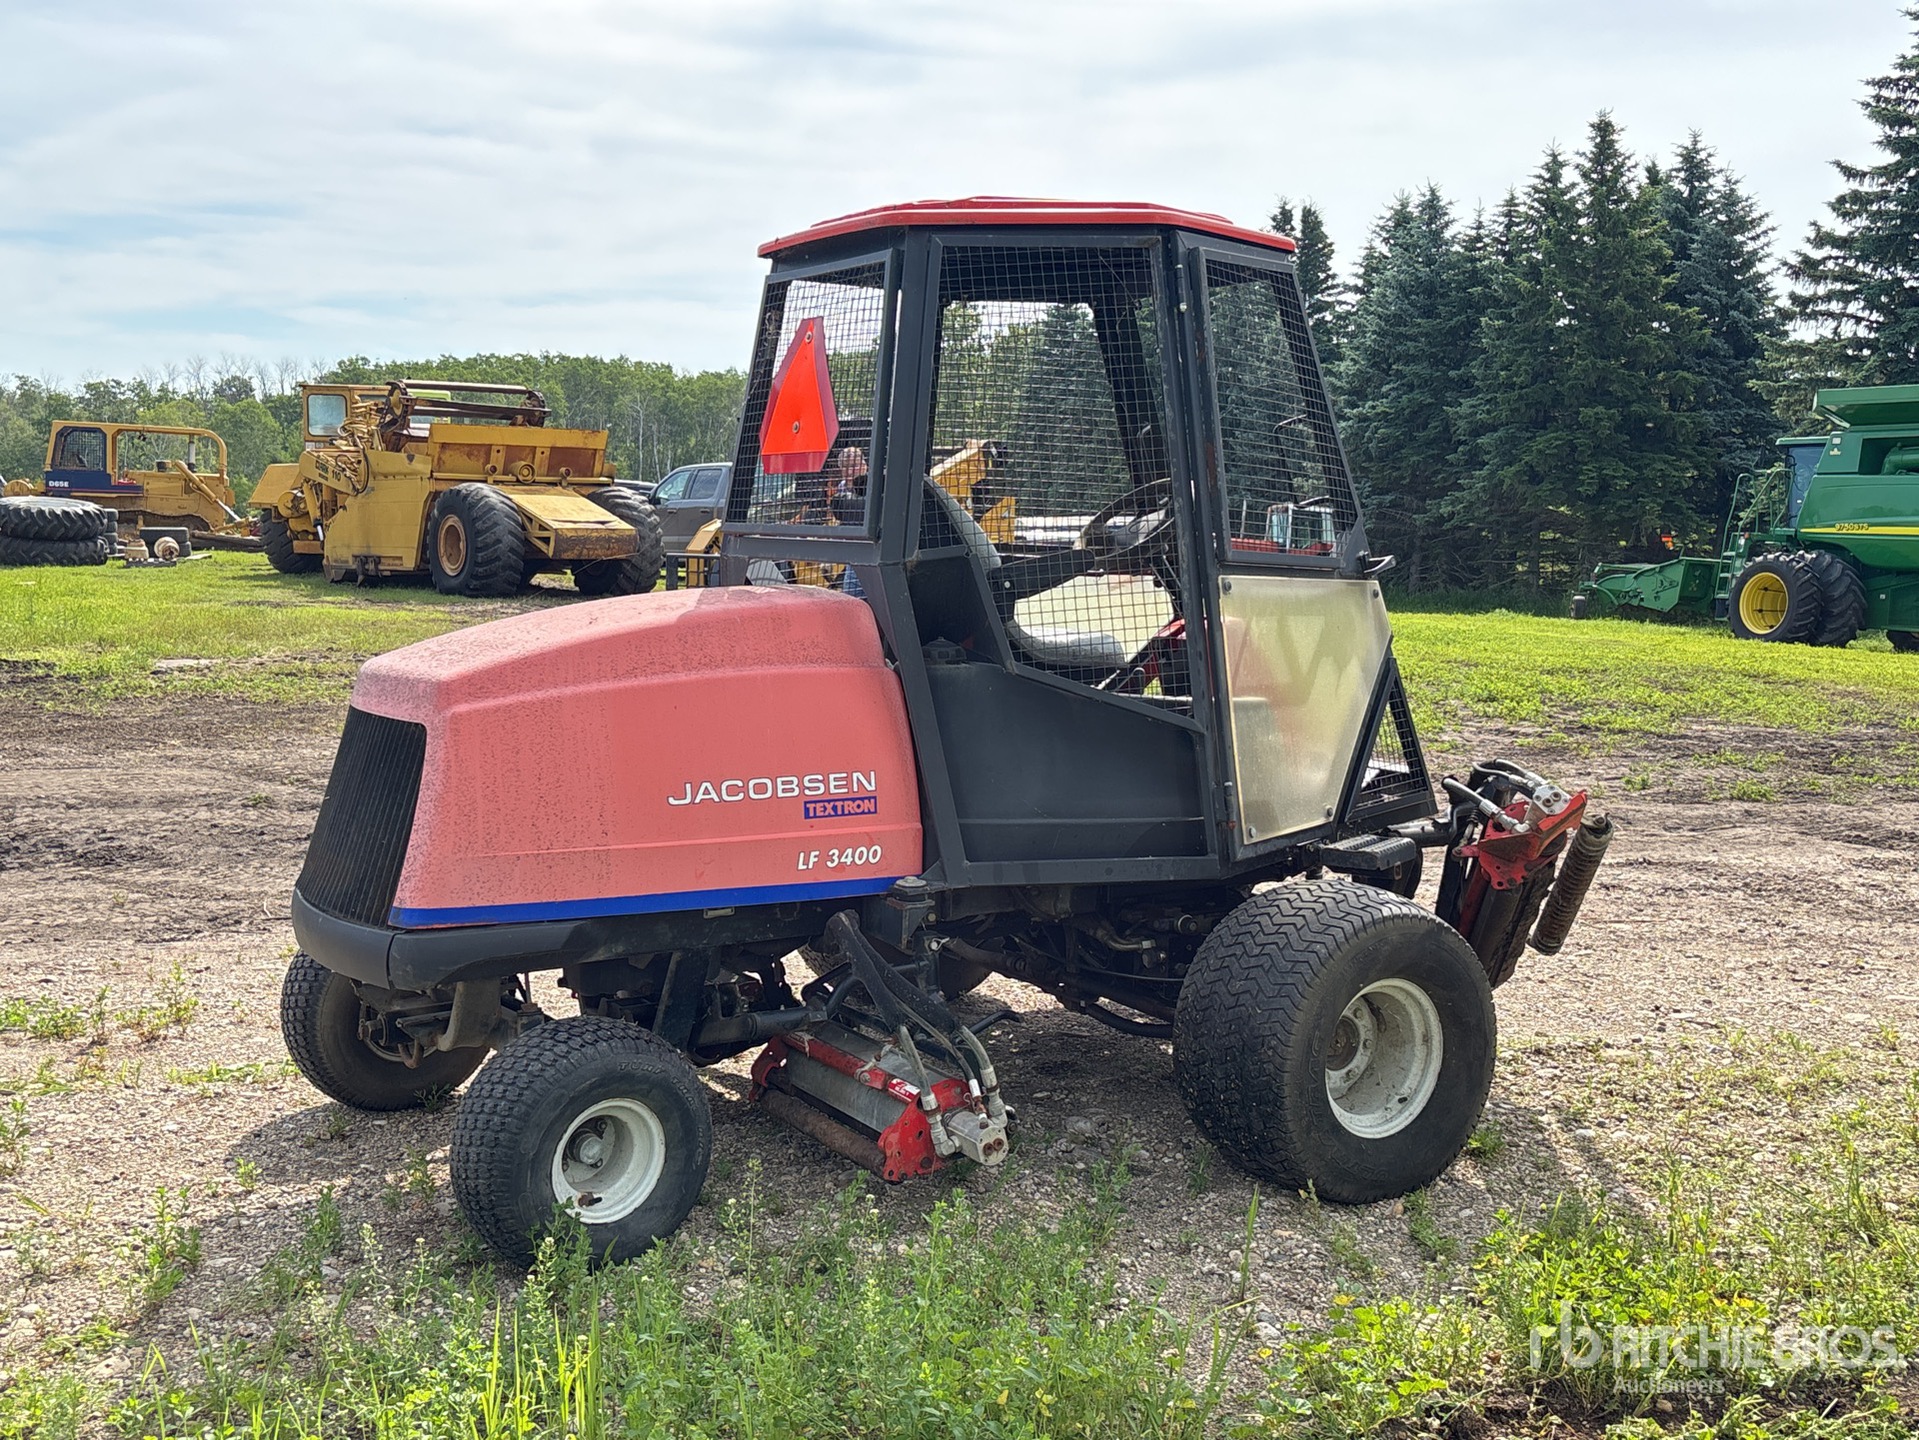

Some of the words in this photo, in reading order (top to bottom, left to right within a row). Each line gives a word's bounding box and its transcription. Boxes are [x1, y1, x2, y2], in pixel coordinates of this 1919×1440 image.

[667, 770, 877, 807] JACOBSEN
[805, 798, 876, 818] TEXTRON
[797, 850, 820, 871] LF
[826, 845, 882, 868] 3400
